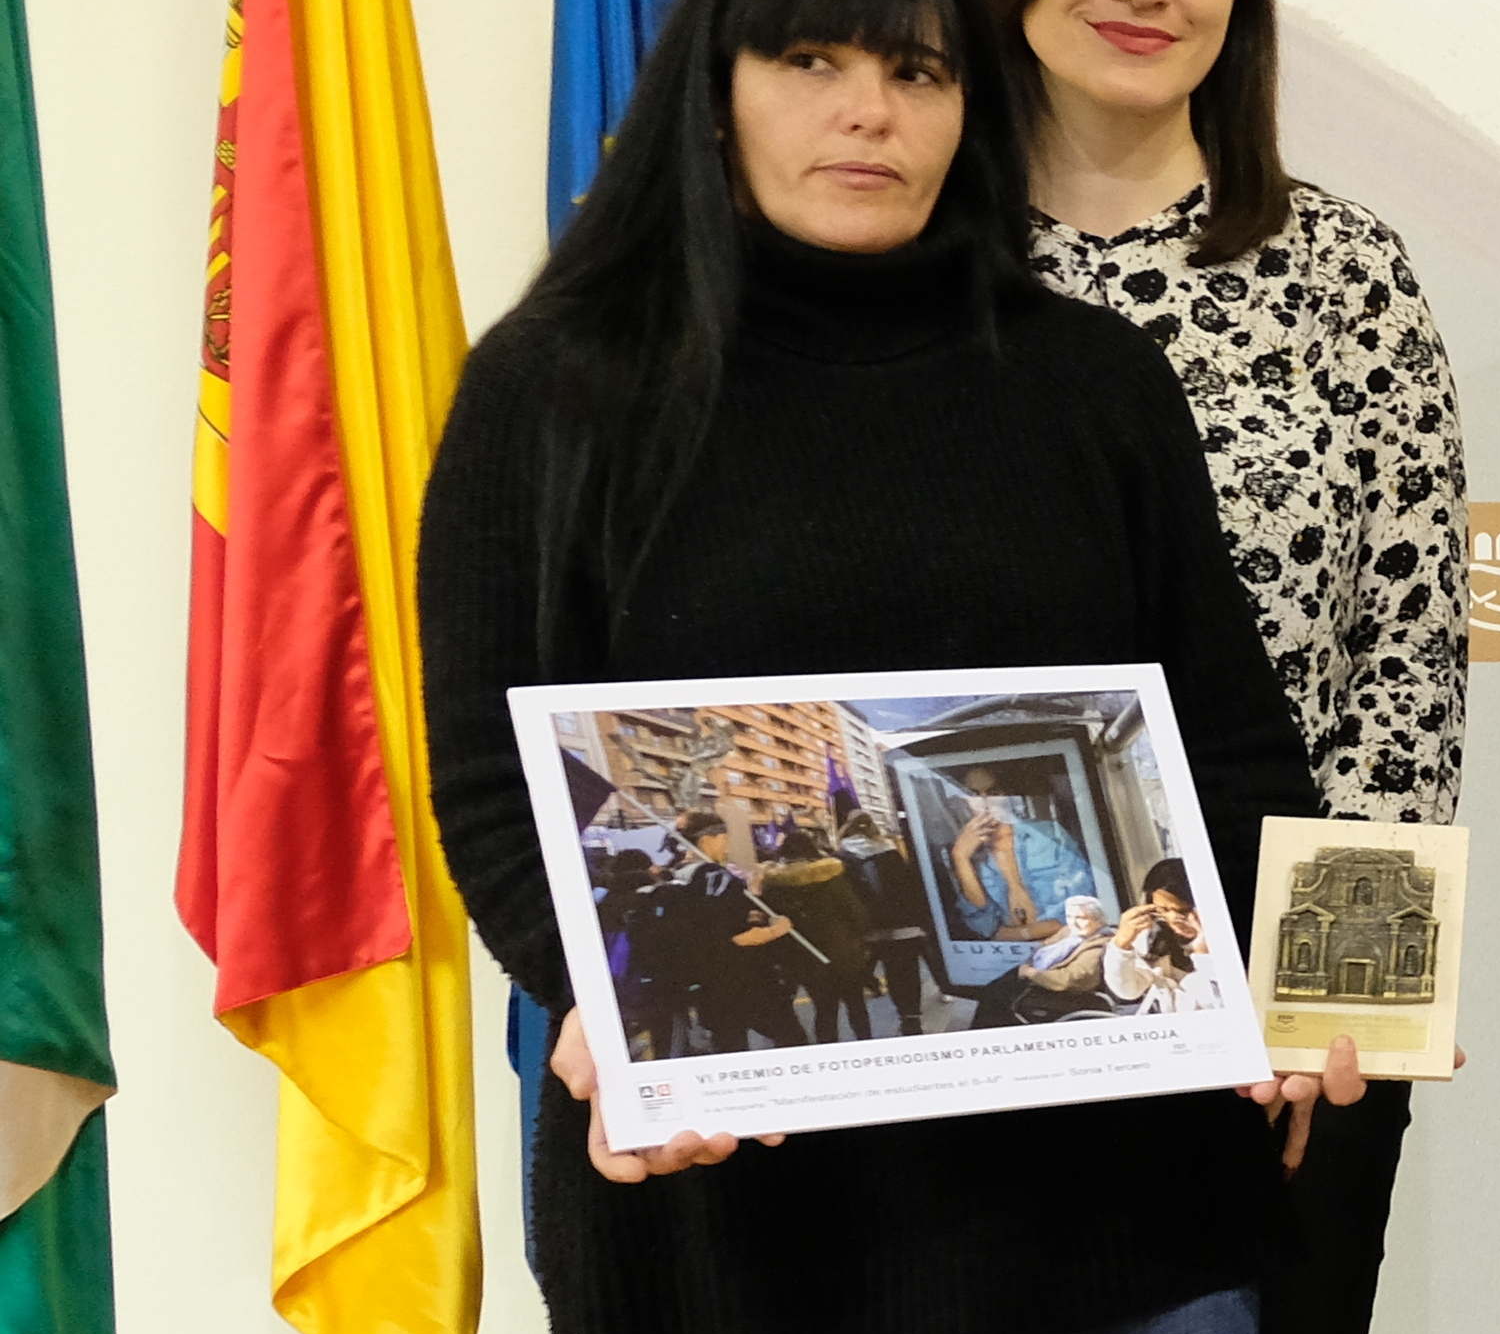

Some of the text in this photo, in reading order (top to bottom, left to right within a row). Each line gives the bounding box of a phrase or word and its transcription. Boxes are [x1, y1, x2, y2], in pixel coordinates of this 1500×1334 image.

[718, 1066, 784, 1082] PREMIO
[790, 1064, 811, 1075] DE
[819, 1048, 965, 1072] FOTOPERIODISMO
[970, 1038, 1077, 1057] PARLAMENTO
[1082, 1034, 1103, 1046] DE
[1108, 1033, 1128, 1045] LA
[1133, 1029, 1179, 1042] RIOJA
